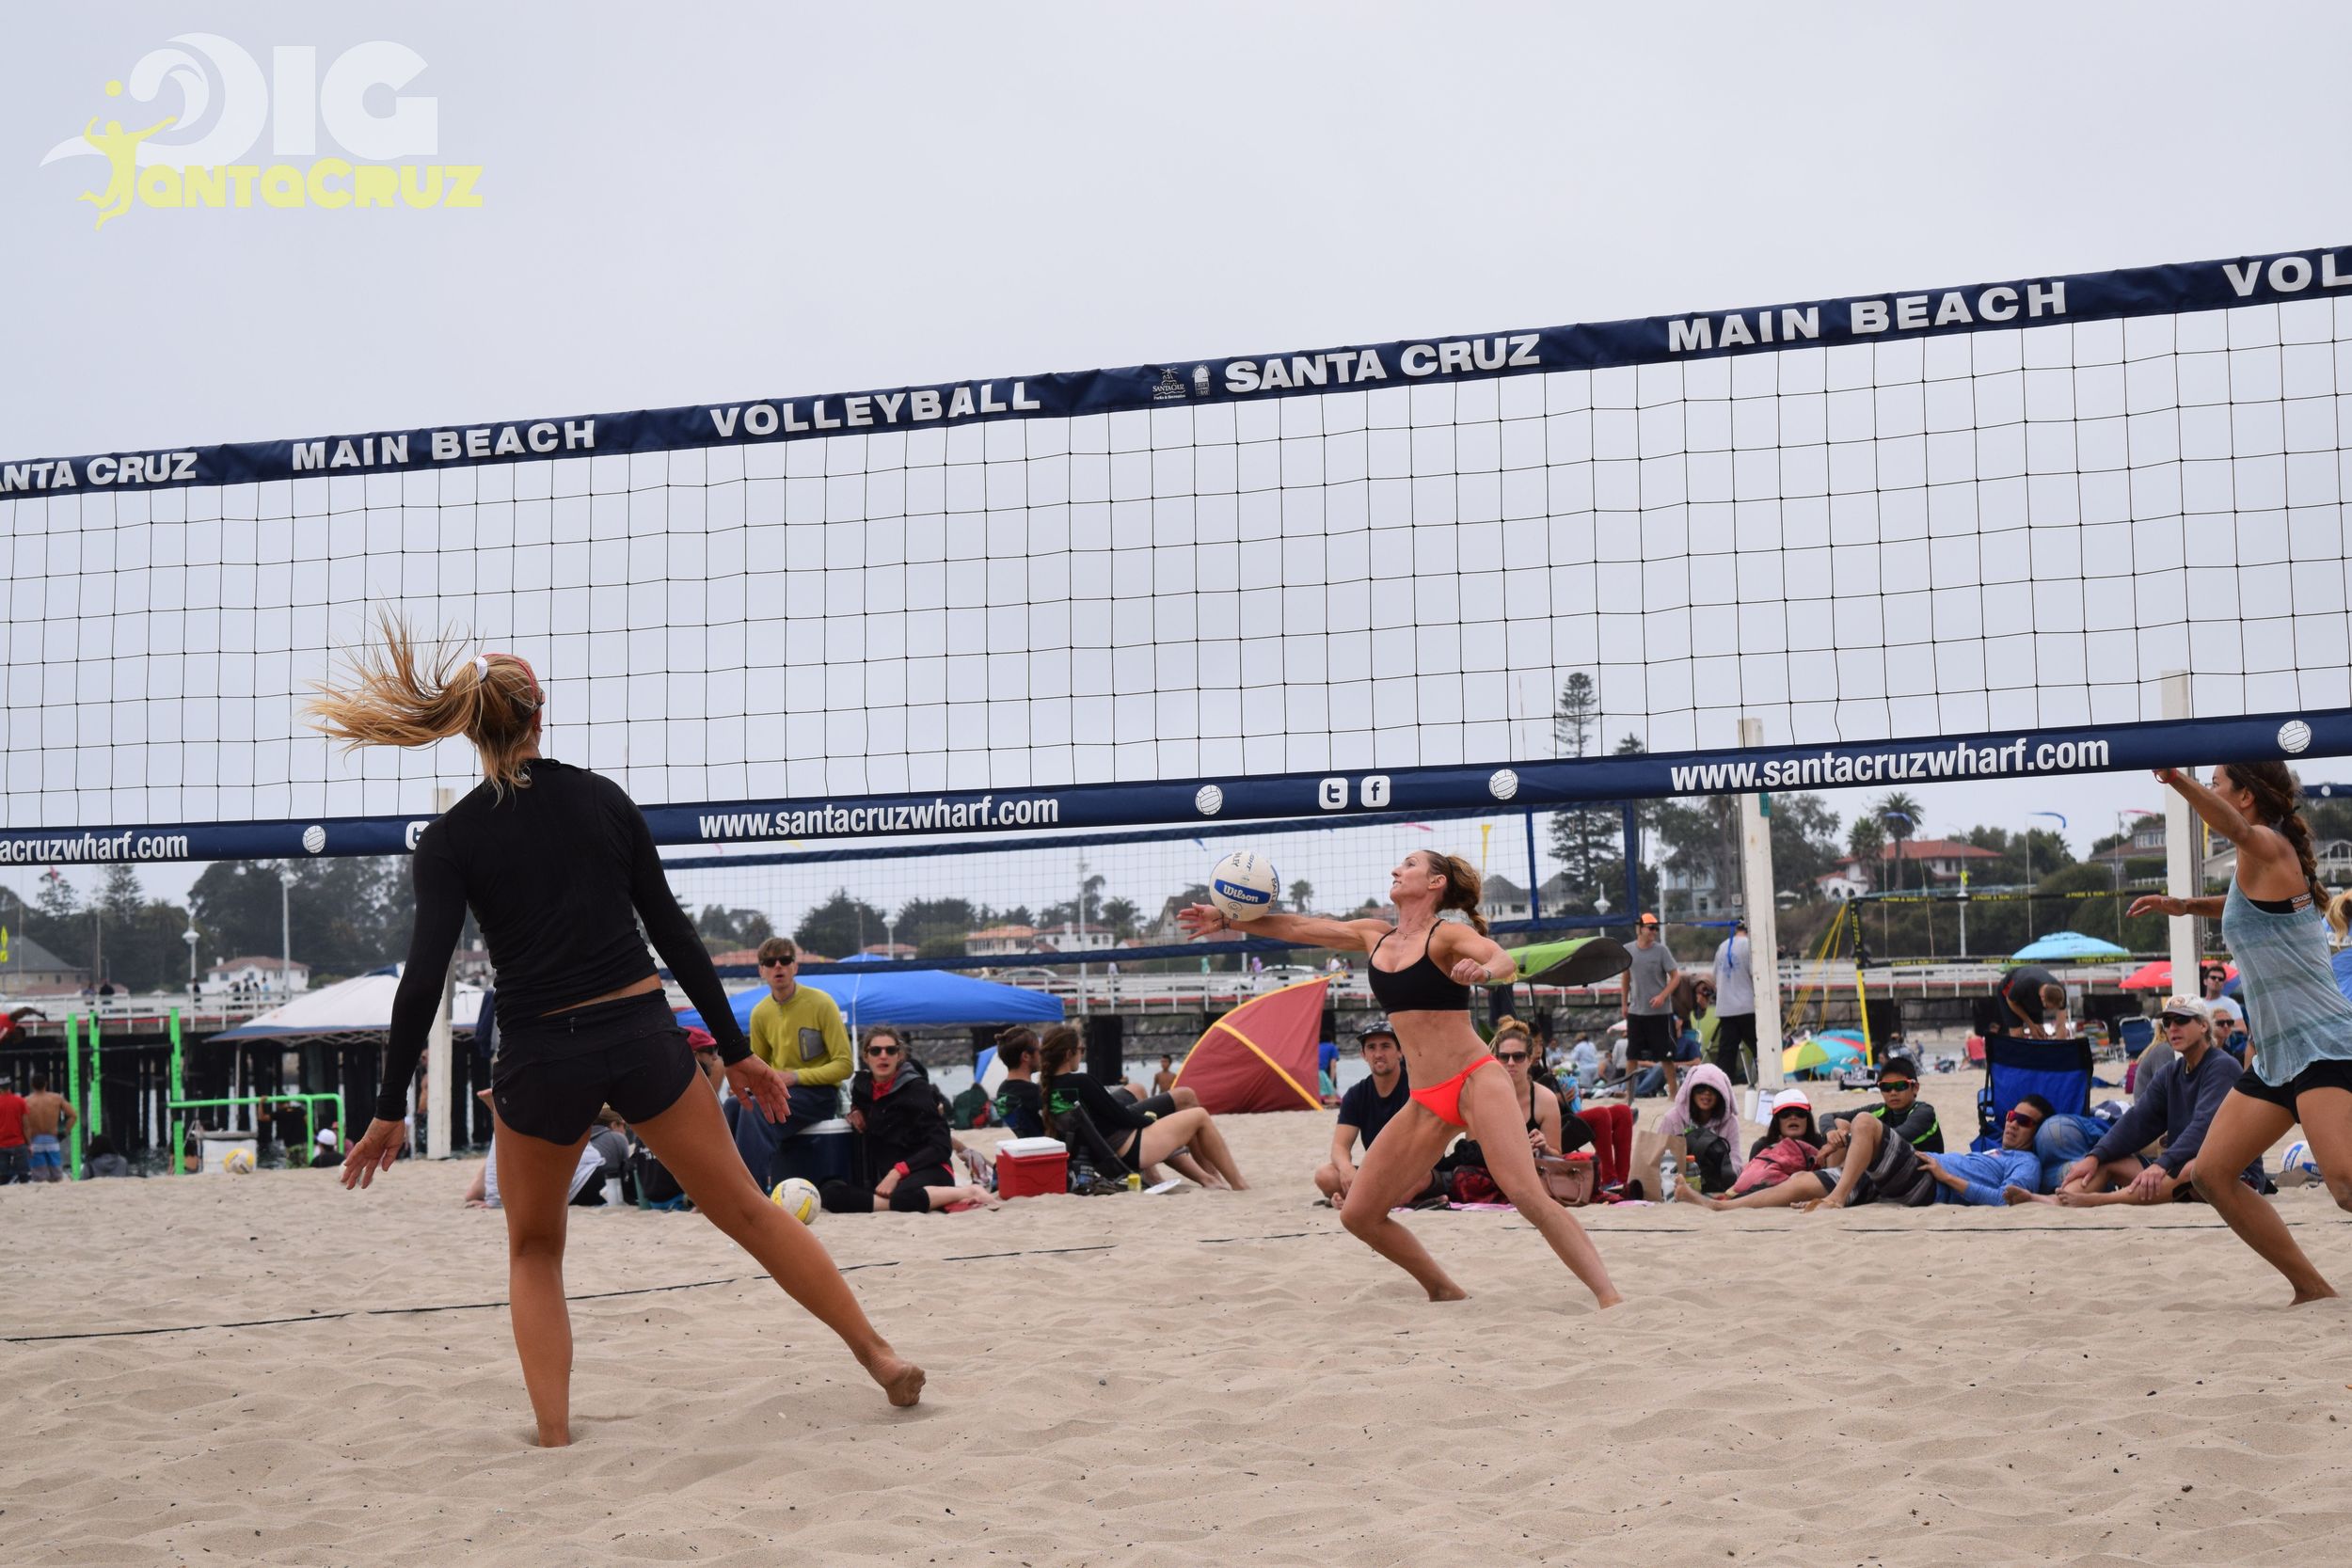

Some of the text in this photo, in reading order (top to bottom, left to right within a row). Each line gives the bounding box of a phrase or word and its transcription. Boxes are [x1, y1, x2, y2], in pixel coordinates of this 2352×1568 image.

[2222, 253, 2352, 297] VOL
[1668, 281, 2067, 352] MAIN BEACH
[1225, 333, 1540, 393] SANTA CRUZ
[709, 381, 1041, 437] VOLLEYBALL
[292, 420, 595, 470] MAIN BEACH
[0, 451, 198, 492] NTA CRUZ
[1670, 737, 2110, 791] www.santacruzwharf.com
[699, 795, 1059, 838] www.santacruzwharf.com
[0, 831, 189, 863] acruzwharf.com
[1223, 884, 1259, 903] Wilson
